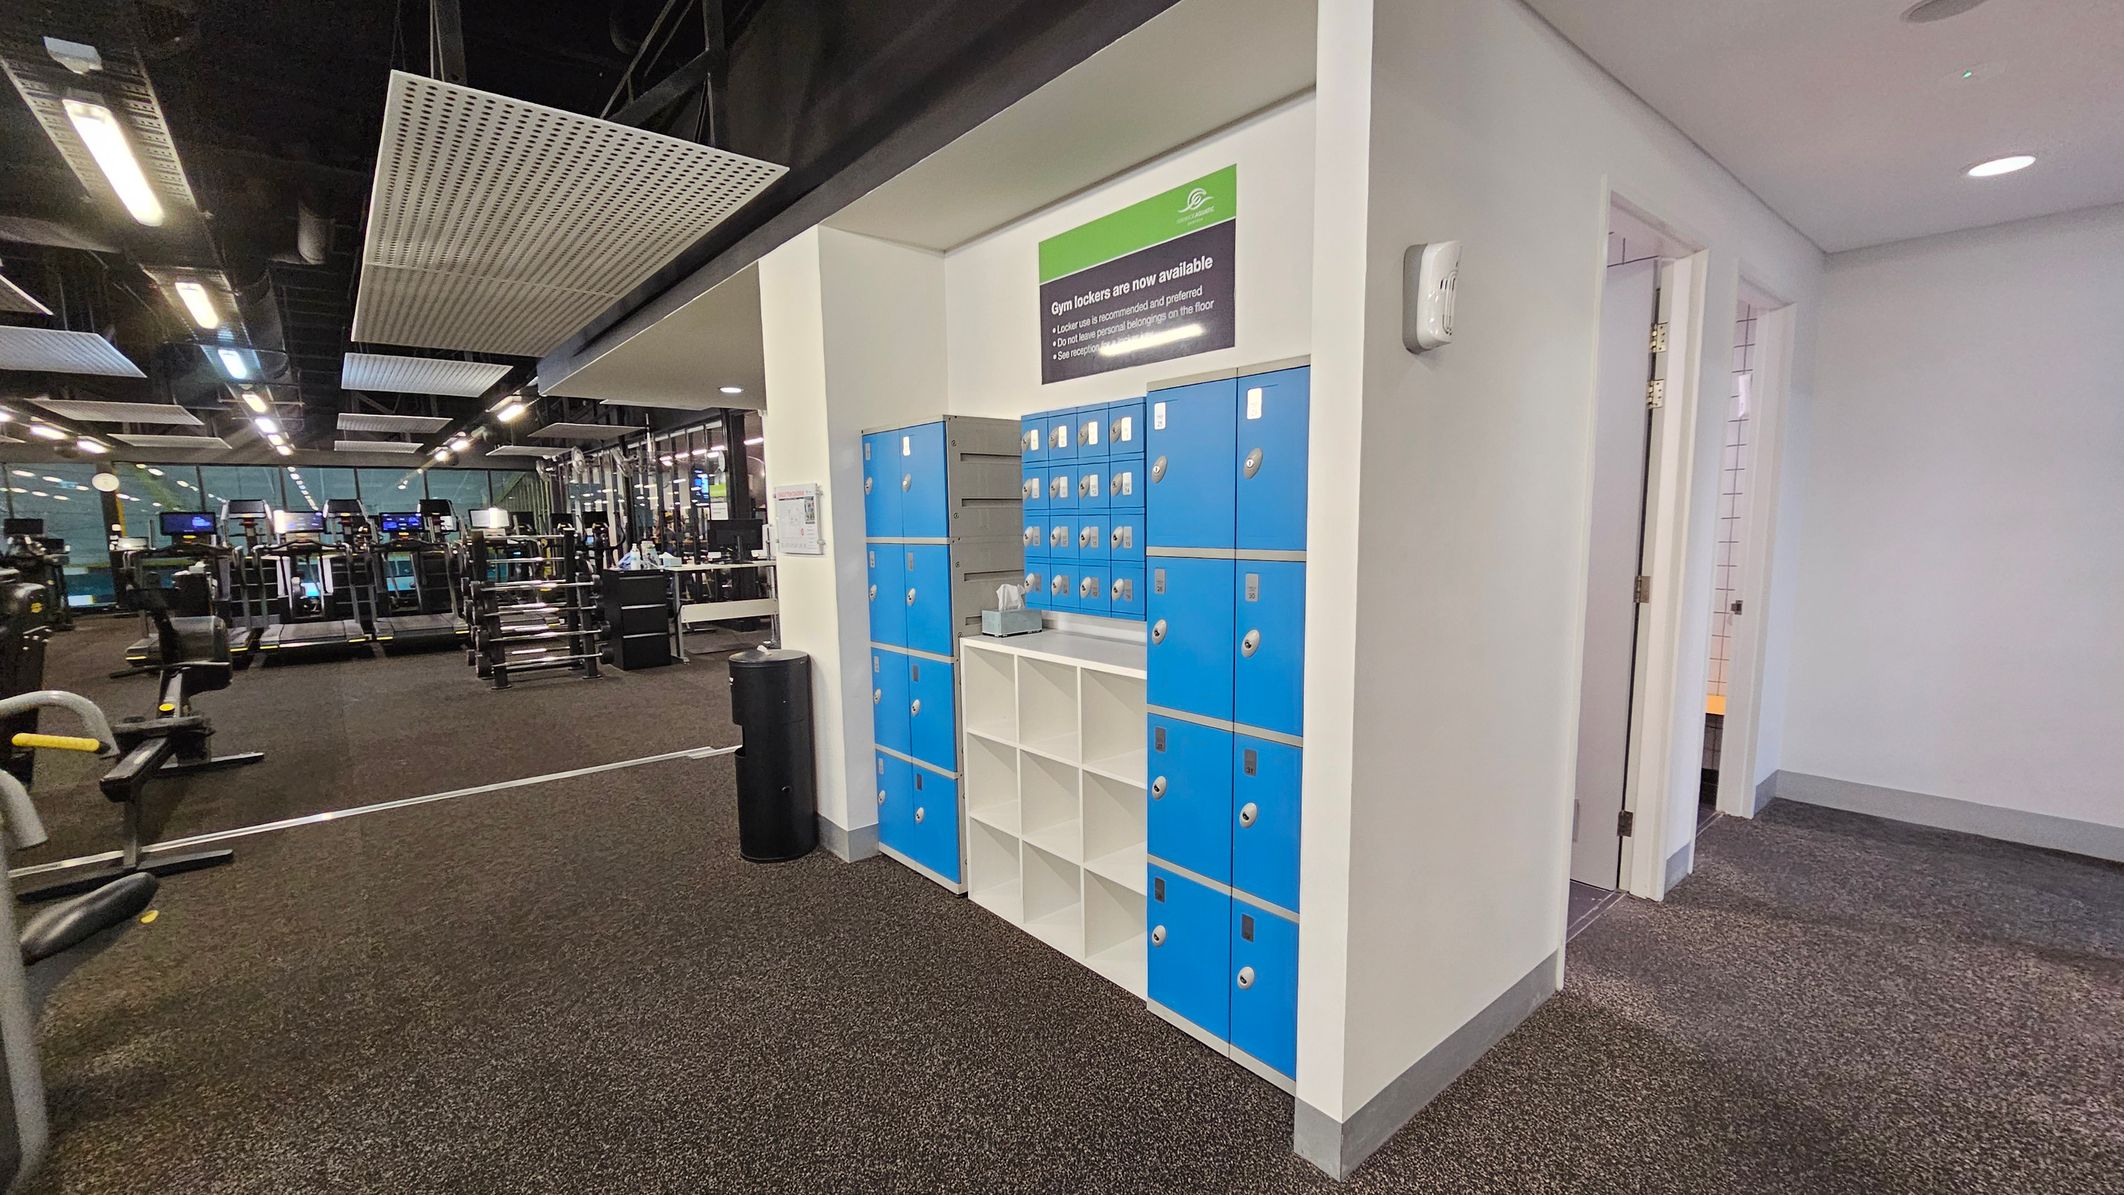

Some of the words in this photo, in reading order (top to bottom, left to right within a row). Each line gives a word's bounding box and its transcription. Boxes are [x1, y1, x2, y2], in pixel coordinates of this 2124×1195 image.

[1051, 300, 1073, 316] Gym
[1074, 288, 1111, 308] lockers
[1112, 281, 1130, 297] are
[1132, 273, 1157, 291] now
[1158, 255, 1213, 283] available
[1057, 321, 1078, 334] Locker
[1079, 318, 1091, 328] use
[1091, 314, 1098, 325] is
[1098, 300, 1149, 323] recommended
[1149, 296, 1165, 309] and
[1166, 285, 1203, 307] preferred
[1057, 337, 1067, 348] Do
[1067, 334, 1078, 345] not
[1079, 331, 1096, 342] leave
[1096, 319, 1126, 339] personal
[1126, 312, 1167, 330] belongings
[1168, 309, 1179, 320] on
[1180, 305, 1194, 316] the
[1194, 300, 1215, 313] floor
[1057, 350, 1070, 361] See
[1070, 344, 1100, 357] reception
